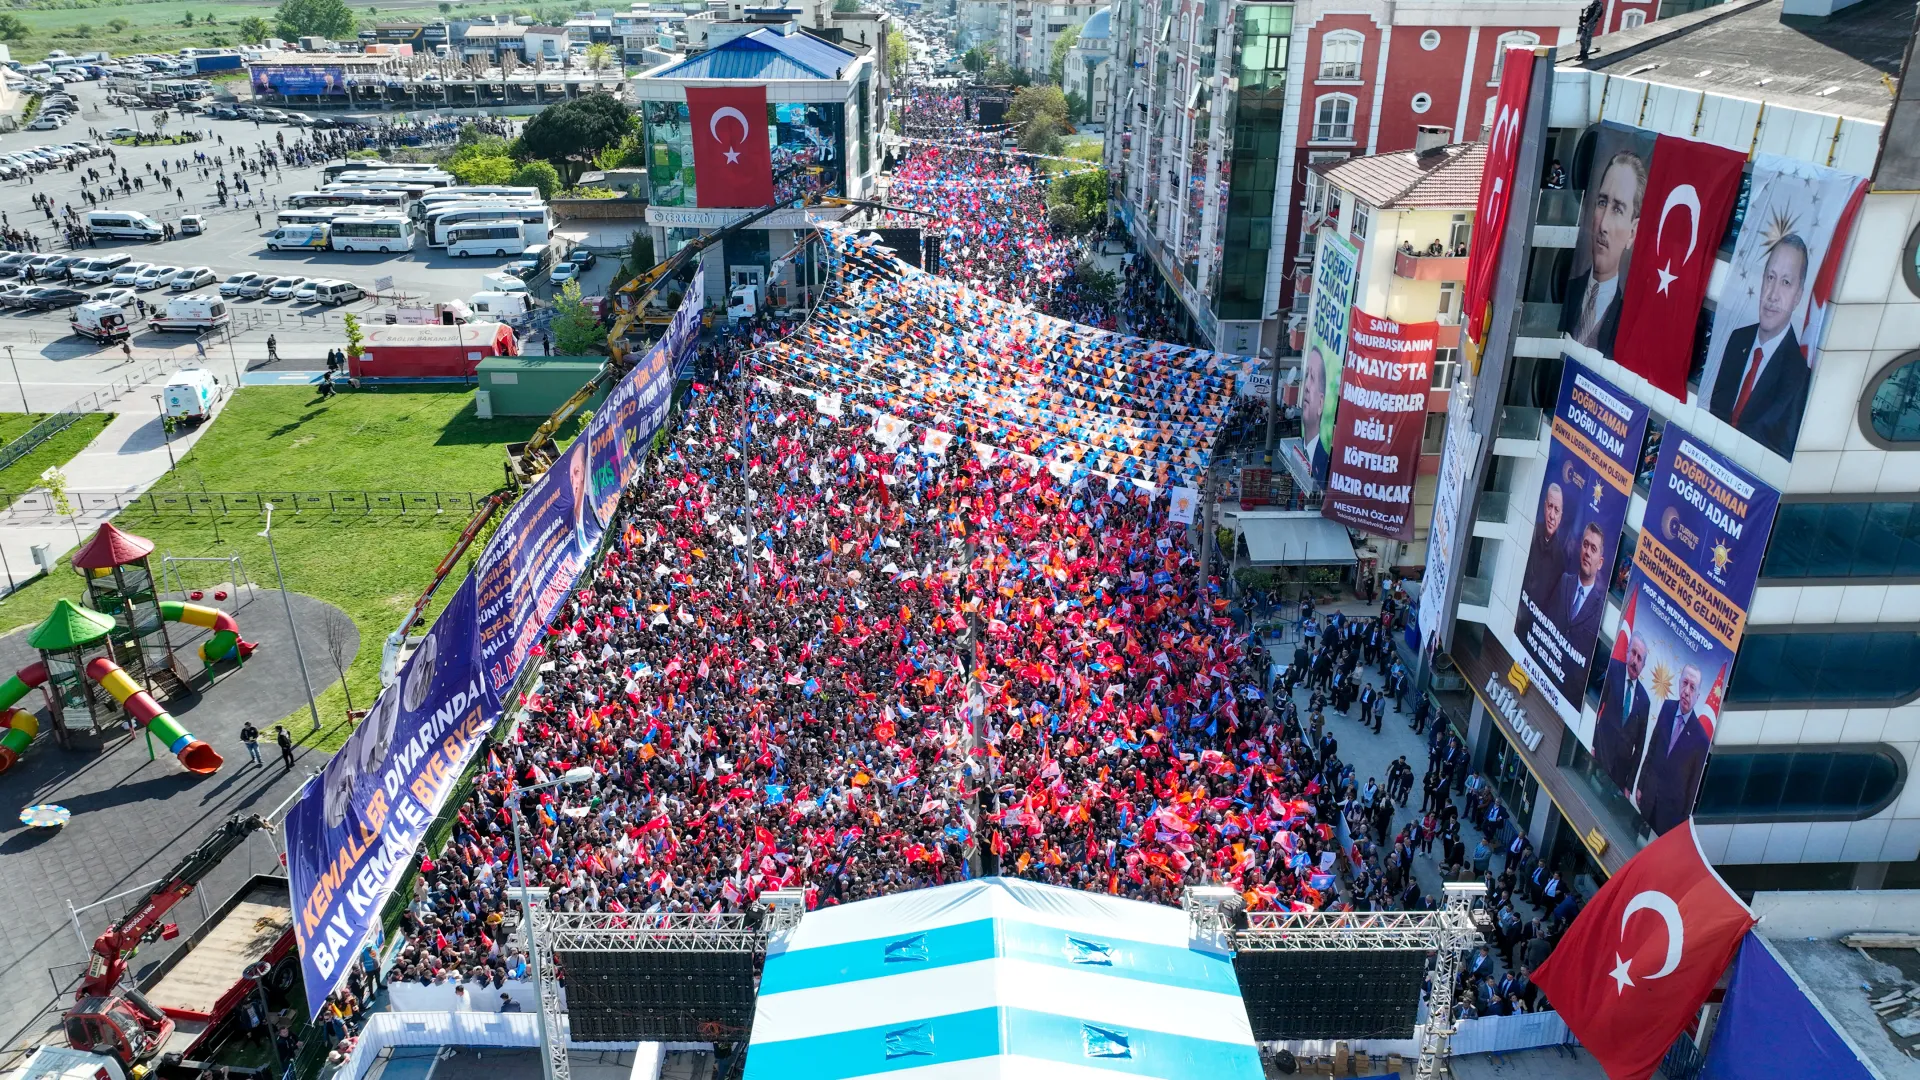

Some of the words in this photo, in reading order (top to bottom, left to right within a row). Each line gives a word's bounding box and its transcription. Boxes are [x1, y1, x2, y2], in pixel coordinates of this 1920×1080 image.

[666, 212, 715, 223] ÇERKEZKÖY
[1318, 265, 1348, 308] ZAMAN
[1321, 244, 1352, 286] DOĞRU
[1370, 319, 1399, 334] SAYIN
[1250, 374, 1273, 385] İDEA
[1353, 416, 1385, 441] DEĞİL
[1567, 403, 1597, 436] DOĞRU
[1595, 427, 1625, 458] ADAM
[1571, 387, 1599, 419] DOĞRU
[1597, 406, 1628, 439] ZAMAN
[1343, 445, 1399, 473] KÖFTELER
[1555, 423, 1571, 442] DÜNYA
[1570, 435, 1592, 459] LİDERİNE
[1591, 451, 1608, 471] SELAM
[1607, 464, 1628, 487] OLSUN!
[1684, 444, 1709, 467] TÜRKİYE
[1709, 463, 1733, 486] YÜZYILI
[1734, 479, 1750, 495] İÇİN
[1330, 471, 1362, 496] HAZIR
[1363, 482, 1412, 504] OLACAK
[1668, 472, 1707, 512] DOĞRU
[1705, 502, 1744, 540] ADAM
[1673, 454, 1708, 489] DOĞRU
[1707, 479, 1748, 519] ZAMAN
[1333, 501, 1369, 518] MESTAN
[1370, 509, 1404, 525] ÖZCAN
[1639, 550, 1676, 592] ŞEHRİMİZE
[1676, 582, 1693, 607] HOŞ
[1693, 601, 1735, 641] GELDİNİZ
[1642, 535, 1652, 554] SN.
[1653, 547, 1740, 625] CUMHURBAŞKANIMIZ
[1529, 600, 1587, 668] CUMHURBAŞKANIM
[1532, 621, 1563, 663] ŞEHRİMİZE
[1642, 582, 1657, 600] PROF.
[1656, 593, 1666, 609] DR.
[1665, 604, 1689, 632] MUSTAFA
[1688, 626, 1714, 651] ŞENTOP
[1650, 601, 1671, 626] TEKİRDAĞ
[1670, 621, 1699, 653] MİLLETVEKİLİ
[482, 630, 508, 660] MİLLİ
[1526, 631, 1538, 652] HOŞ
[1537, 645, 1566, 684] GELDİNİZ
[1522, 657, 1531, 670] AV.
[1531, 667, 1540, 681] ALİ
[1539, 677, 1559, 706] GÜMÜŞ
[302, 788, 390, 939] KEMALLER
[311, 902, 354, 981] BAY
[410, 755, 450, 807] BYE
[442, 704, 482, 763] BYE!
[122, 913, 145, 934] KÖROĞLU
